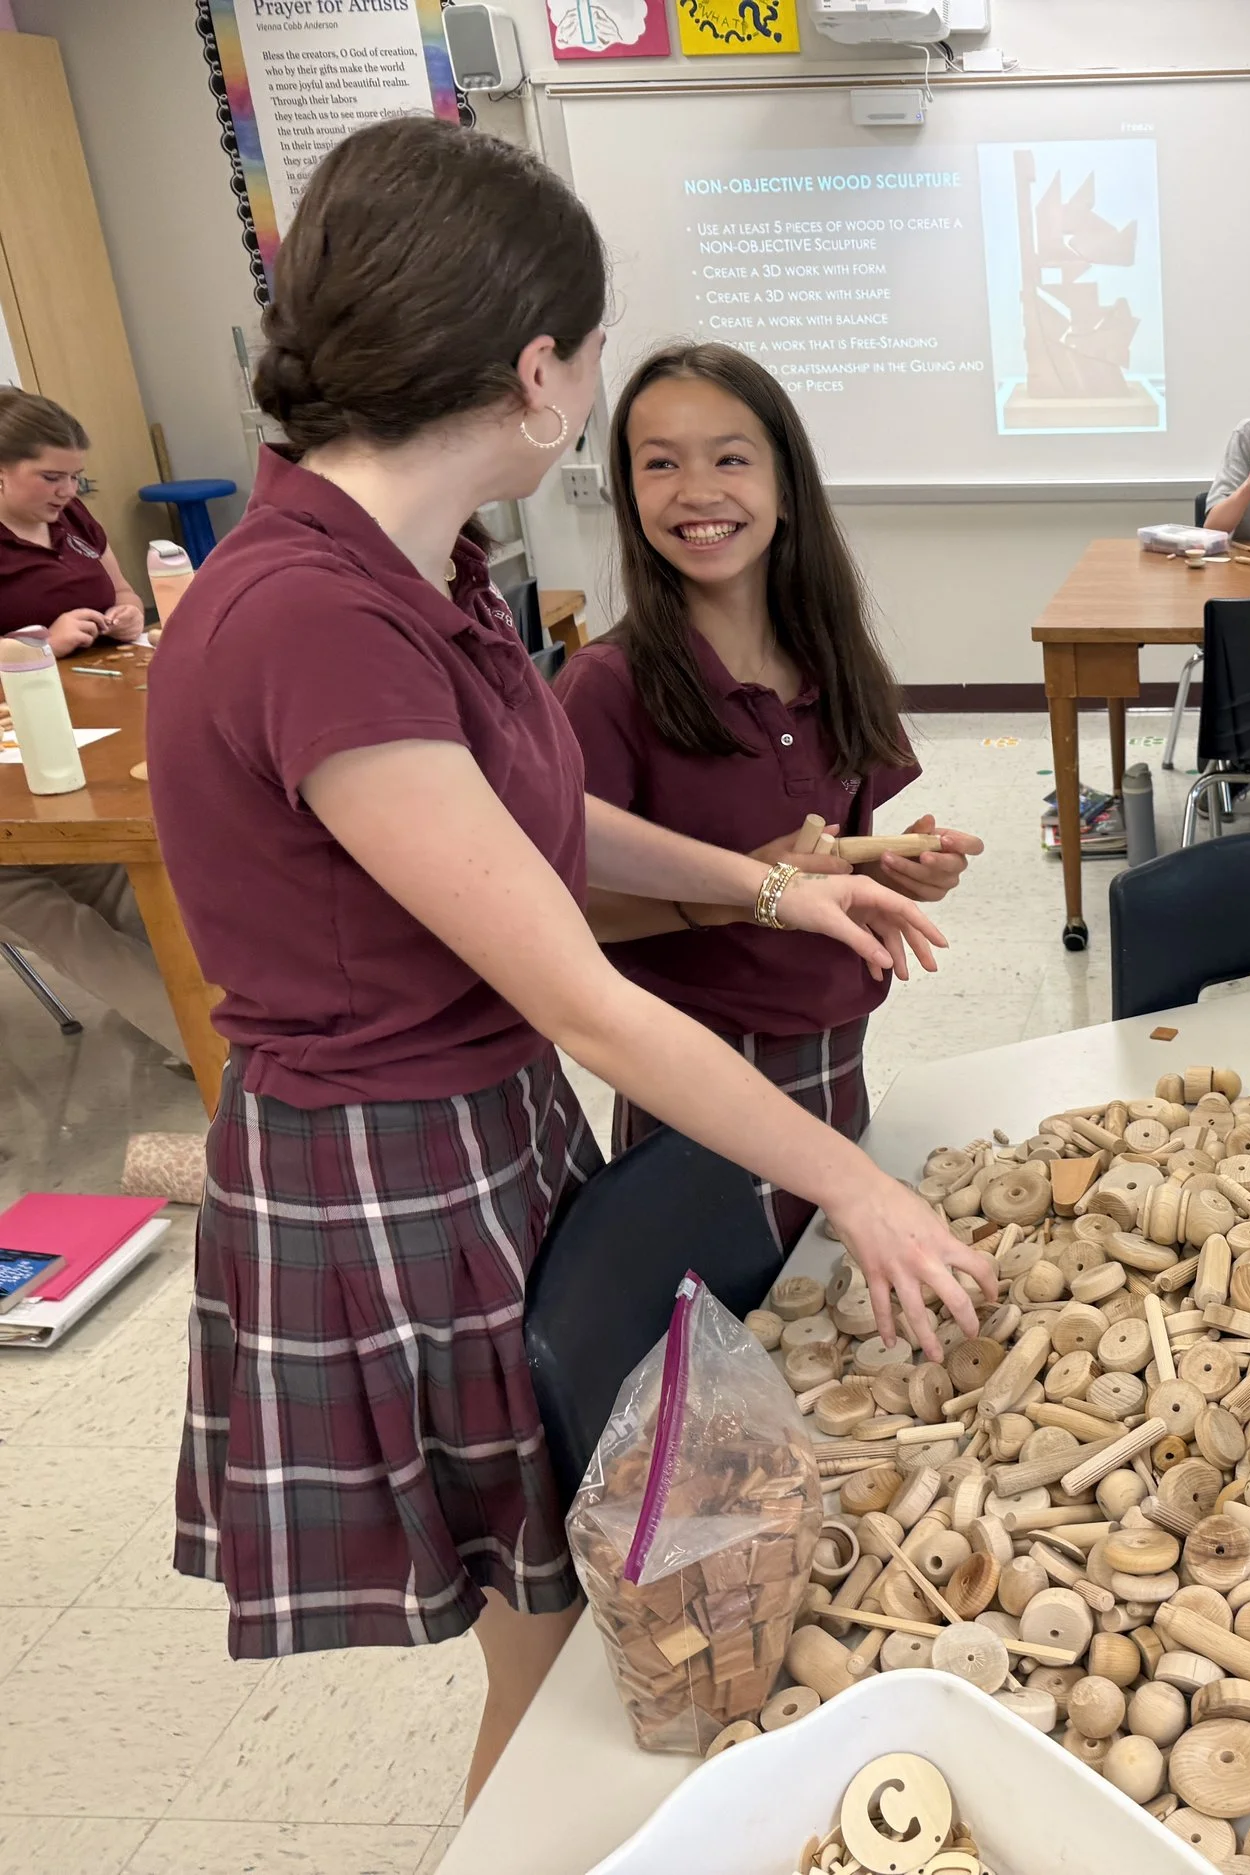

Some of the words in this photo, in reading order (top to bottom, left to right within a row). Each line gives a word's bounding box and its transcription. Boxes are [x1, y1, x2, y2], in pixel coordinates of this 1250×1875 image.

[254, 0, 312, 19] Prayer
[318, 0, 343, 13] for
[348, 0, 409, 12] Artists
[256, 23, 282, 32] Vienna
[303, 20, 339, 30] Anderson
[262, 51, 284, 61] Bless
[286, 50, 300, 60] the
[301, 49, 339, 60] creators,
[340, 48, 348, 58] O
[349, 47, 367, 58] God
[369, 46, 379, 57] of
[379, 47, 418, 58] creation,
[265, 65, 284, 76] who
[285, 65, 296, 77] by
[297, 63, 317, 75] their
[319, 63, 338, 76] gifts
[339, 63, 364, 74] make
[364, 62, 379, 73] the
[379, 61, 405, 72] world
[275, 83, 298, 91] more
[299, 79, 323, 92] joyful
[325, 79, 341, 90] and
[342, 77, 381, 89] beautiful
[382, 77, 410, 88] realm.
[270, 95, 308, 107] Through
[309, 94, 329, 105] their
[330, 94, 358, 104] labors
[274, 112, 293, 123] they
[294, 110, 317, 121] teach
[318, 112, 329, 120] us
[329, 110, 339, 120] to
[340, 111, 355, 119] see
[356, 110, 379, 119] more
[379, 107, 408, 118] clearl
[277, 126, 292, 136] the
[293, 125, 314, 136] truth
[316, 123, 346, 135] around
[280, 141, 291, 151] In
[291, 140, 312, 151] their
[283, 155, 301, 168] they
[303, 155, 318, 166] call
[286, 171, 295, 180] in
[684, 176, 813, 195] NON-OBJECTIVE
[817, 174, 872, 192] WOOD
[876, 171, 962, 190] SCULPTURE
[722, 223, 737, 235] AT
[739, 223, 770, 235] LEAST
[774, 220, 782, 234] 5
[785, 221, 823, 234] PIECES
[826, 220, 842, 232] OF
[845, 219, 885, 231] WOOD
[889, 218, 904, 231] TO
[907, 217, 951, 230] CREATE
[953, 217, 963, 229] A
[700, 238, 811, 254] NON-OBJECTIVE
[750, 267, 760, 278] A
[762, 264, 782, 278] 3D
[784, 265, 820, 277] WORK
[822, 264, 849, 276] WITH
[852, 263, 887, 275] FORM
[753, 292, 763, 303] A
[765, 289, 785, 303] 3D
[787, 290, 823, 301] WORK
[825, 289, 852, 300] WITH
[855, 288, 891, 300] SHAPE
[757, 317, 766, 328] A
[769, 316, 803, 327] WORK
[806, 314, 832, 326] WITH
[835, 313, 889, 325] BALANCE
[760, 341, 769, 352] A
[771, 340, 806, 351] WORK
[809, 340, 835, 350] THAT
[781, 362, 870, 375] CRAFTSMANSHIP
[873, 362, 885, 373] IN
[887, 362, 907, 373] THE
[958, 360, 985, 372] AND
[787, 381, 802, 392] OF
[867, 1778, 921, 1843] C
